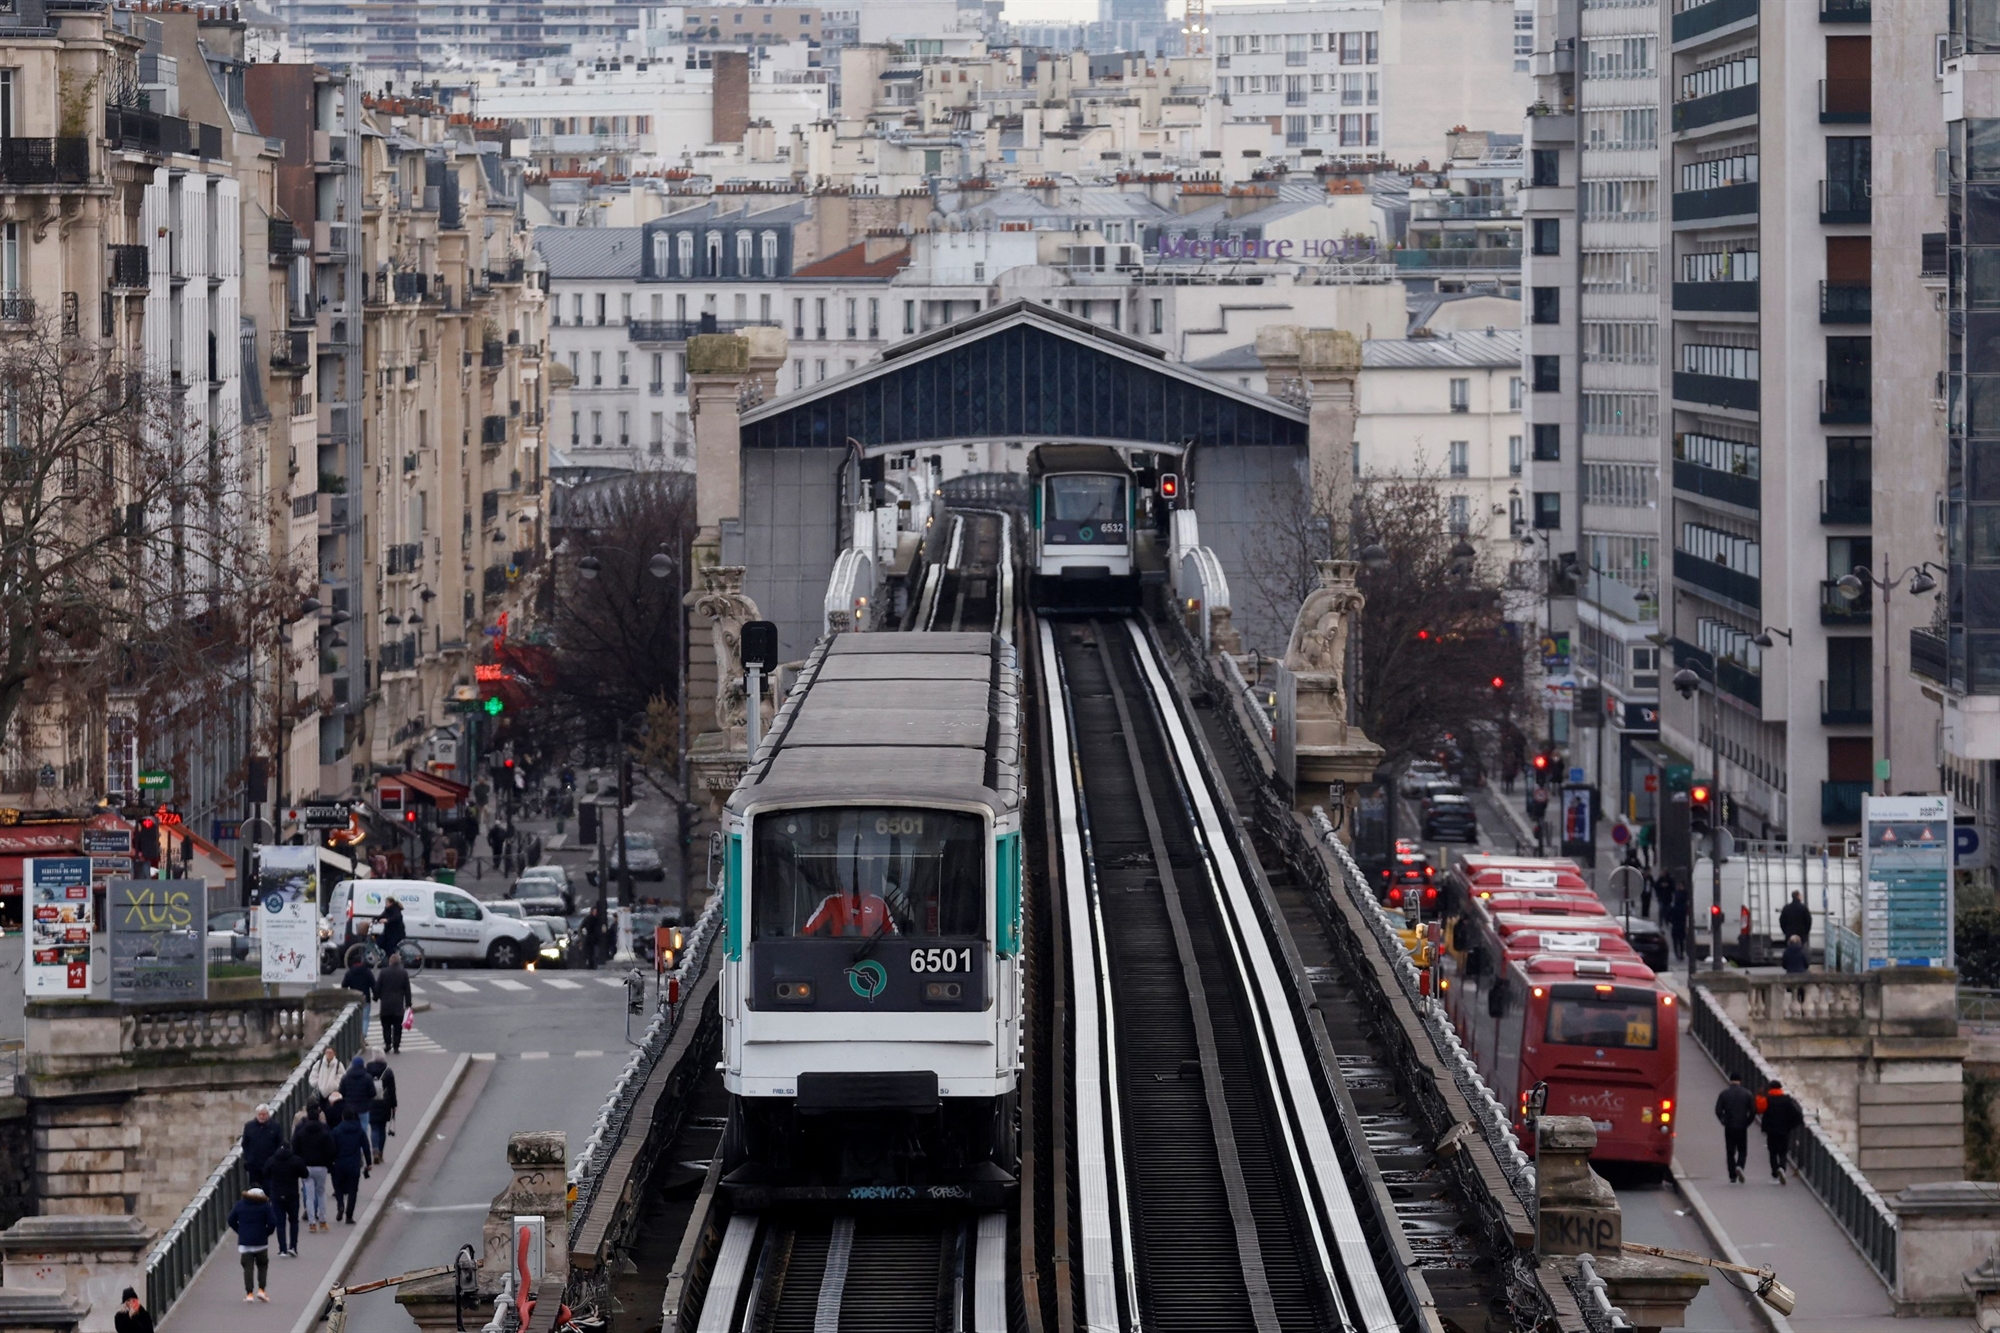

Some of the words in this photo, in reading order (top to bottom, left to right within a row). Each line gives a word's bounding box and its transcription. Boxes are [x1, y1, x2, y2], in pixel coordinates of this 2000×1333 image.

[1159, 235, 1294, 259] Mercure
[1100, 523, 1124, 533] 6532
[875, 816, 924, 835] 6501
[125, 888, 192, 926] XUS
[910, 948, 971, 973] 6501
